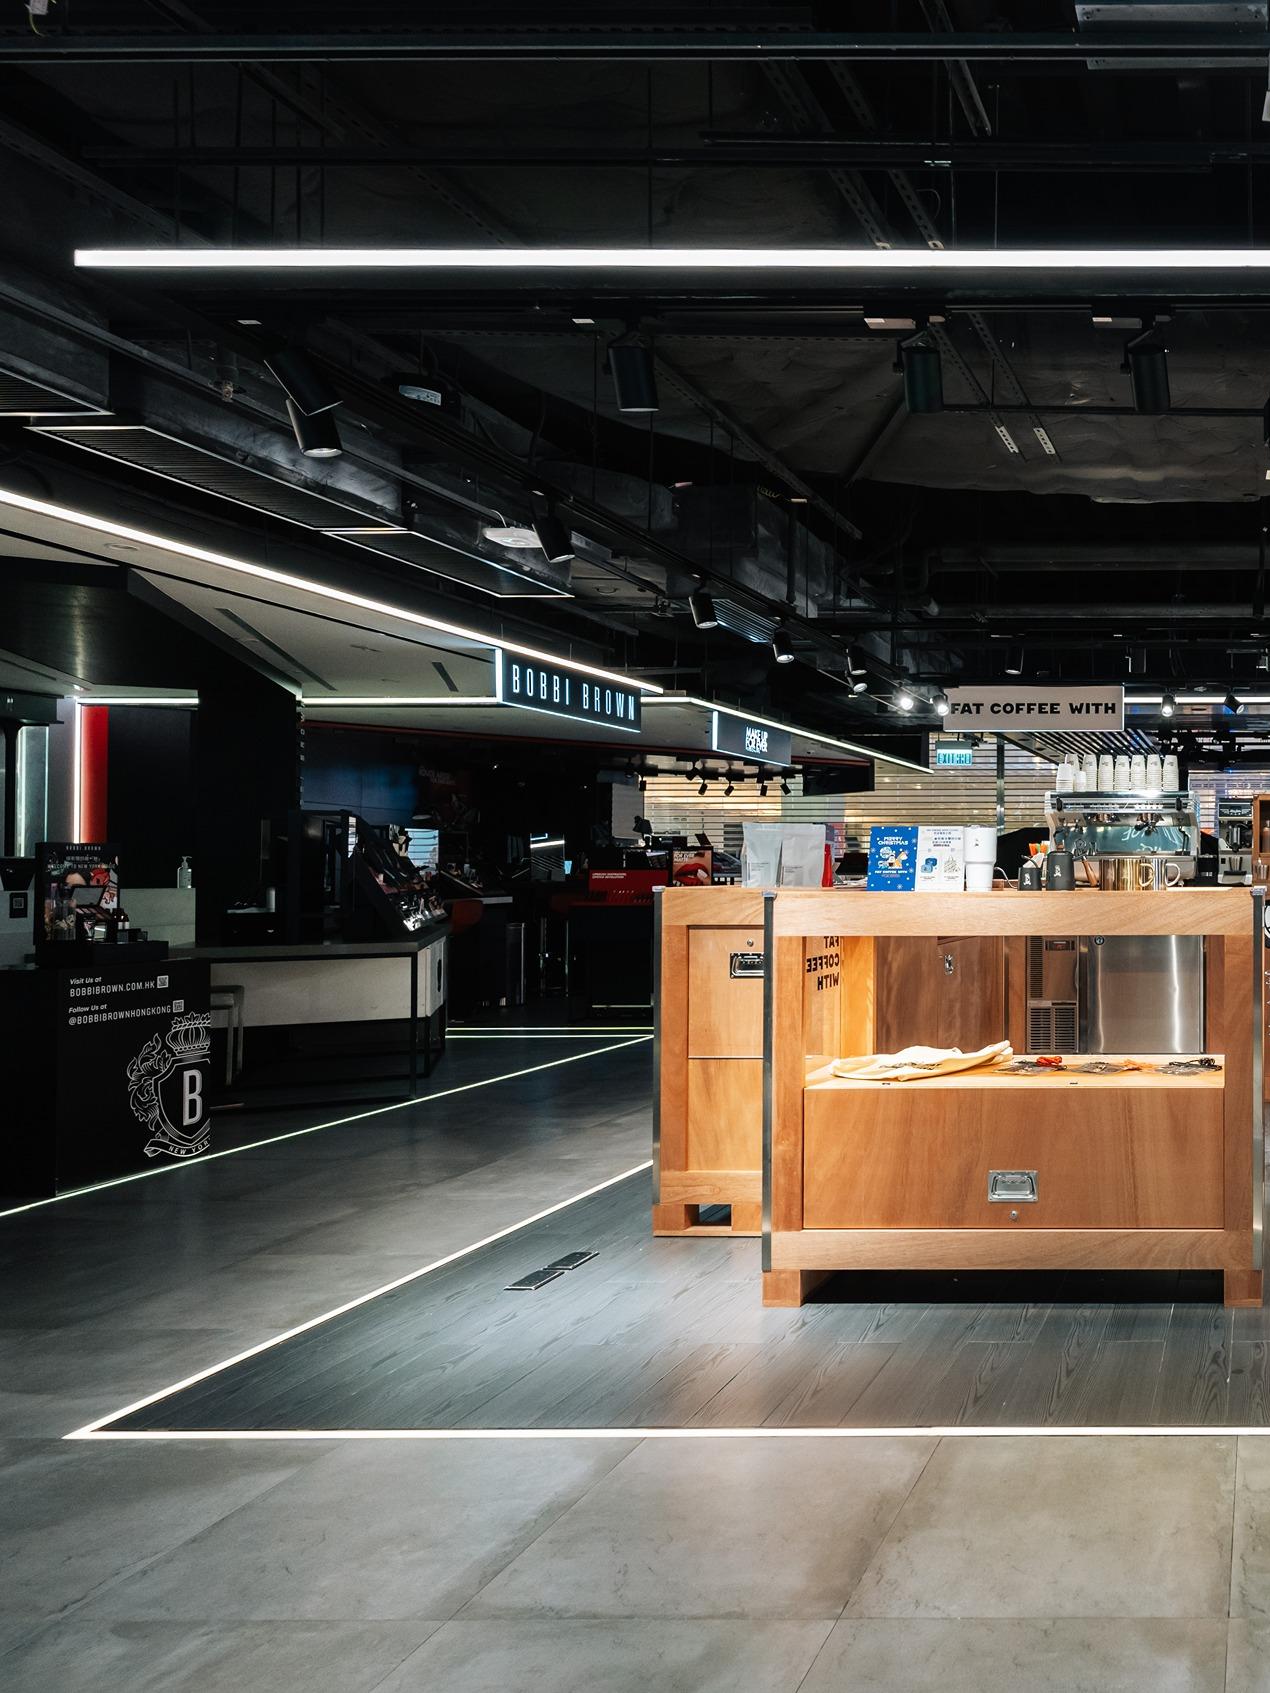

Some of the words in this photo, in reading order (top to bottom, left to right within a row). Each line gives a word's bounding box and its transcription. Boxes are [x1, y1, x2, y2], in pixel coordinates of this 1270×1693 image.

[512, 664, 569, 706] BOBBI
[582, 683, 635, 721] BROWN
[951, 703, 984, 714] FAT
[990, 703, 1060, 714] COFFEE
[1068, 703, 1116, 714] WITH
[937, 753, 954, 763] EXIT
[70, 980, 155, 997] BOBBIBROWN.COM.HK
[68, 1005, 90, 1014] Follow
[68, 1005, 171, 1026] @BOBBIBROWNHONGKONG
[182, 1069, 203, 1126] B
[169, 1145, 187, 1155] NEW
[191, 1137, 210, 1153] YOR
